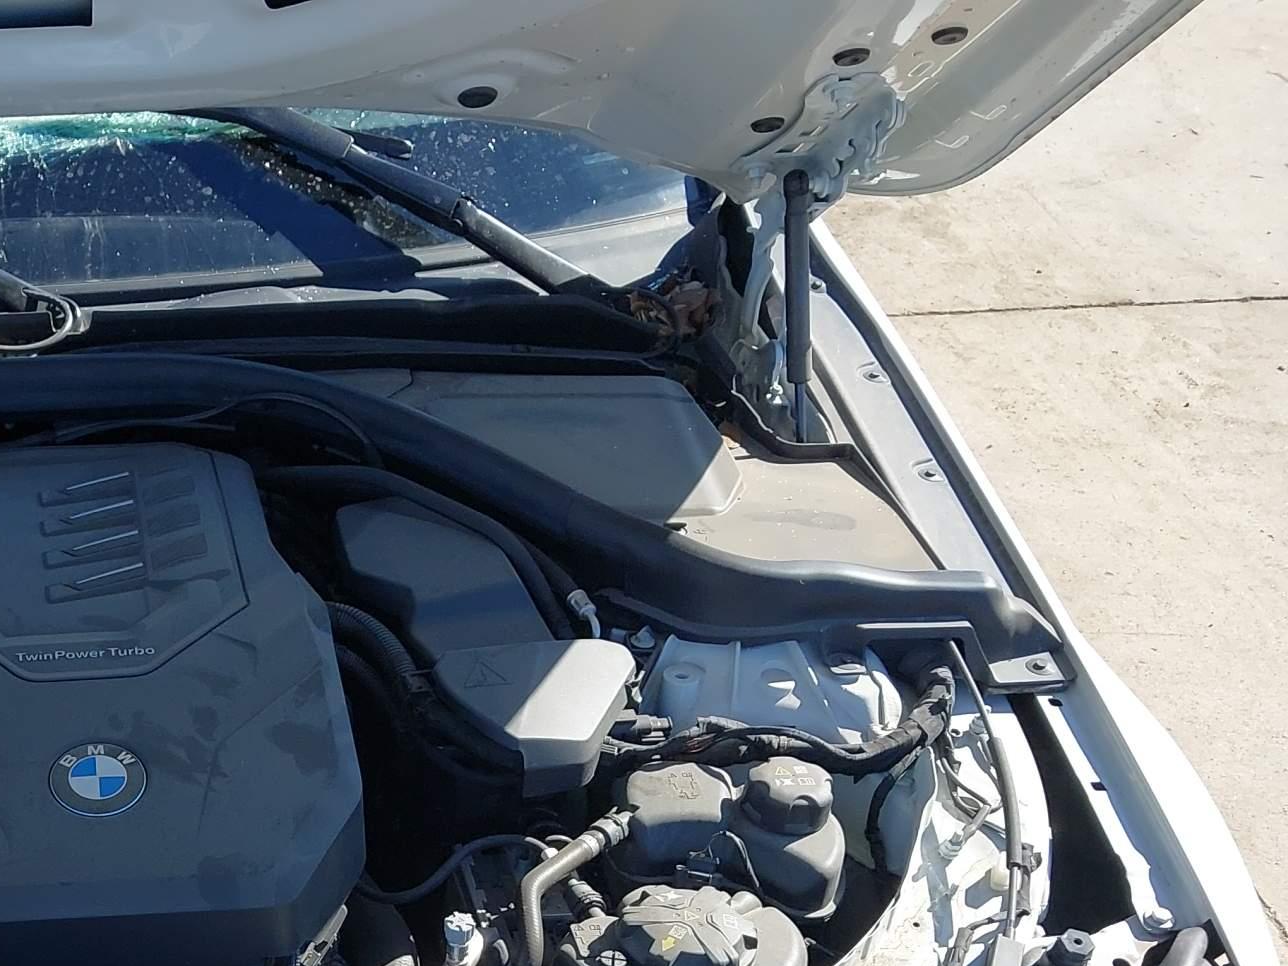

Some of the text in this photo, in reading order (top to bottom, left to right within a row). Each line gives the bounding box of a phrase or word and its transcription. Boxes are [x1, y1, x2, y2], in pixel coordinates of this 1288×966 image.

[15, 646, 155, 662] TwinPower Turbo
[59, 744, 137, 768] BMW
